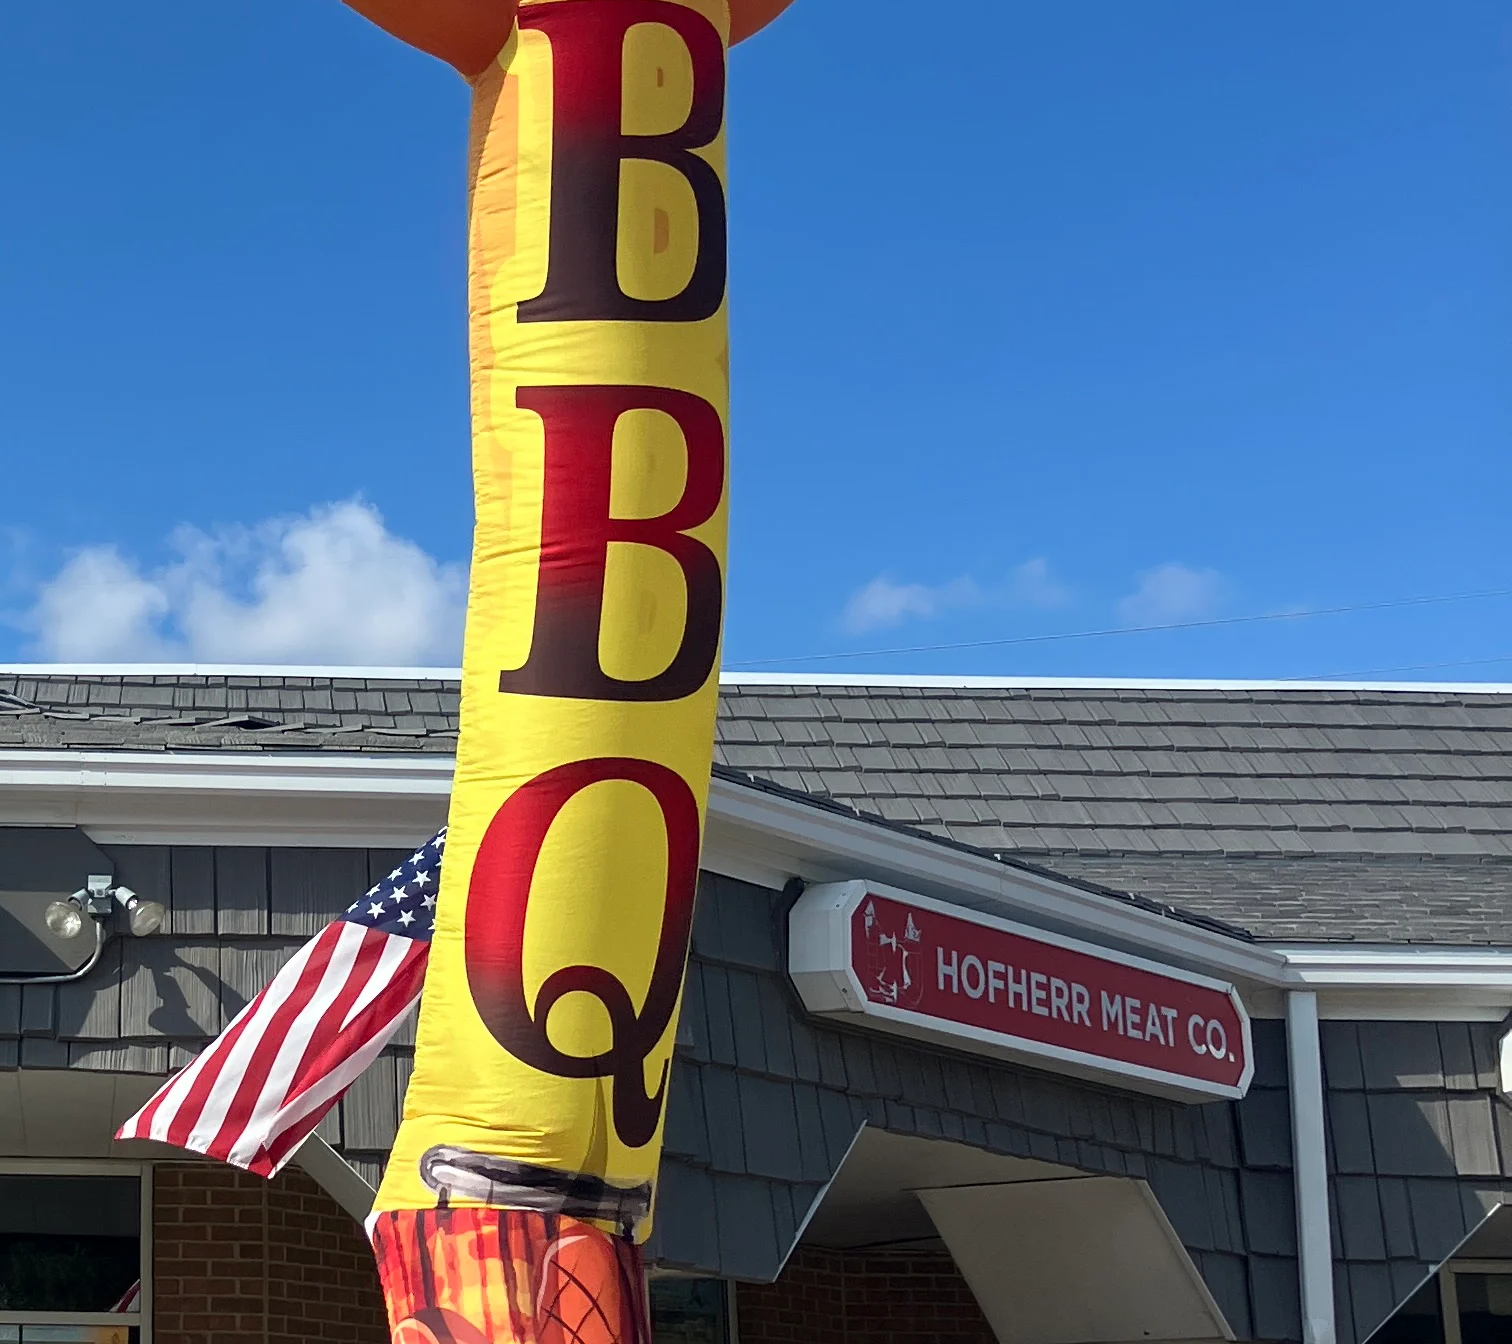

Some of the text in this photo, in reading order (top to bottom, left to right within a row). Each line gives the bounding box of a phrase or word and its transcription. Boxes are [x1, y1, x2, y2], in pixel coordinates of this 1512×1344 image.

[936, 946, 1235, 1063] HOFHERR MEAT CO.
